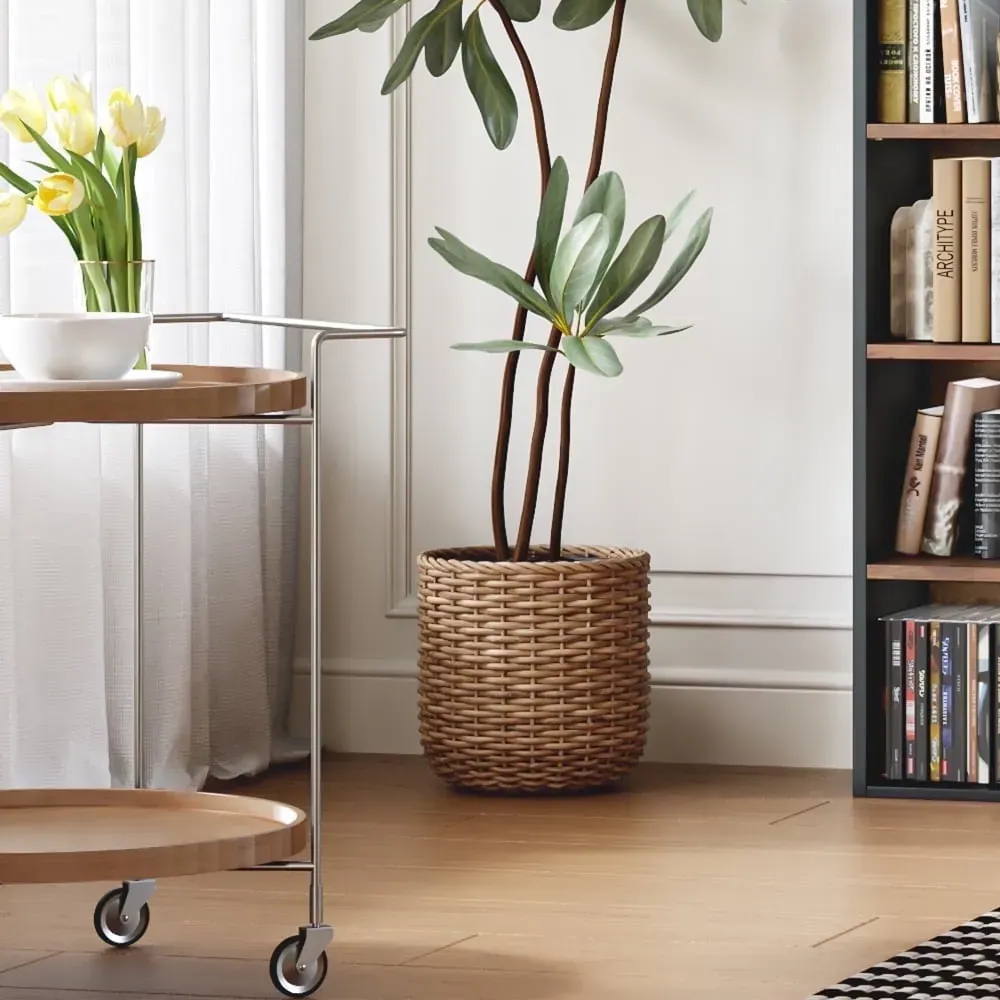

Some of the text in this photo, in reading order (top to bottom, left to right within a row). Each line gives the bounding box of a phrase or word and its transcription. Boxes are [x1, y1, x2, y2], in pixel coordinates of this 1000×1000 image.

[951, 60, 961, 112] BOOK COVER
[936, 209, 954, 279] ARCHITYPE
